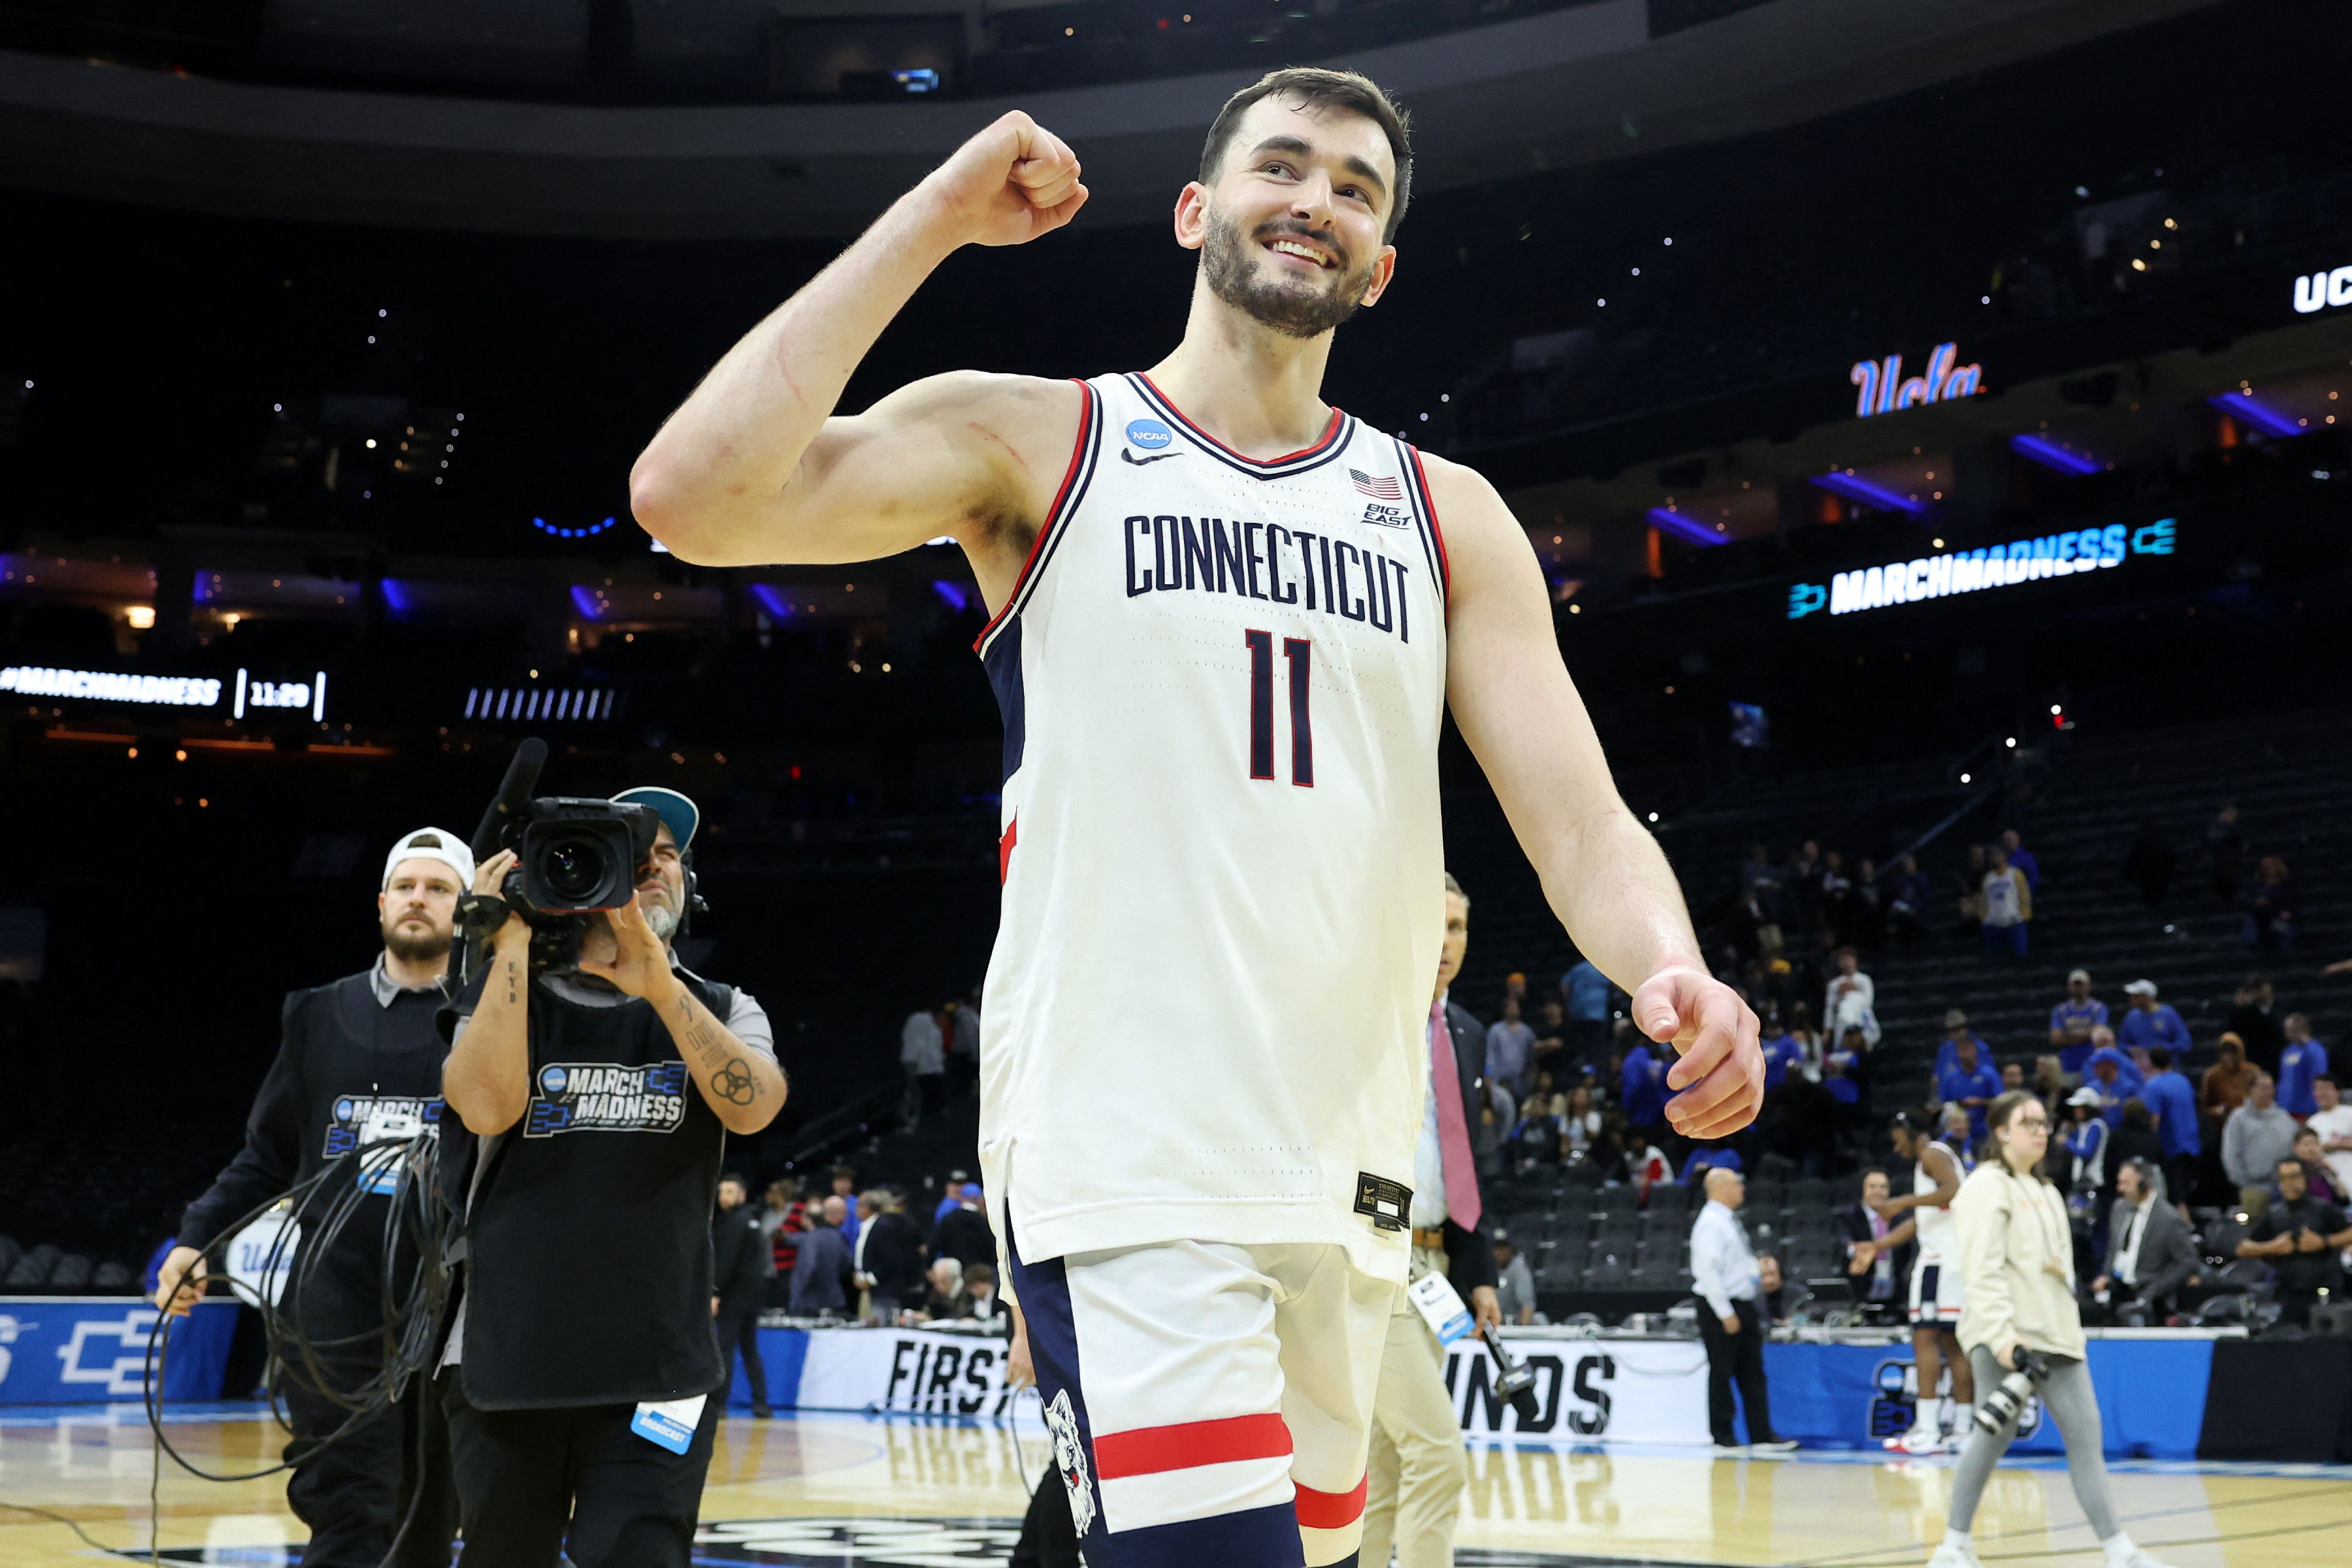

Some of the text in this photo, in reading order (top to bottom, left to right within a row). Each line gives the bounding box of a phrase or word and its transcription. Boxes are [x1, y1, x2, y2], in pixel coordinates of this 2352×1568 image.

[1132, 432, 1169, 441] NCAA
[1364, 511, 1412, 525] EAST
[1367, 503, 1401, 515] BIG
[1124, 515, 1408, 644] CONNECTICUT
[1829, 524, 2127, 615] MARCHMADNESS
[1245, 628, 1313, 788] 11
[566, 1068, 645, 1095] MARCH
[575, 1094, 683, 1121] MADNESS
[1445, 1354, 1615, 1435] NDS
